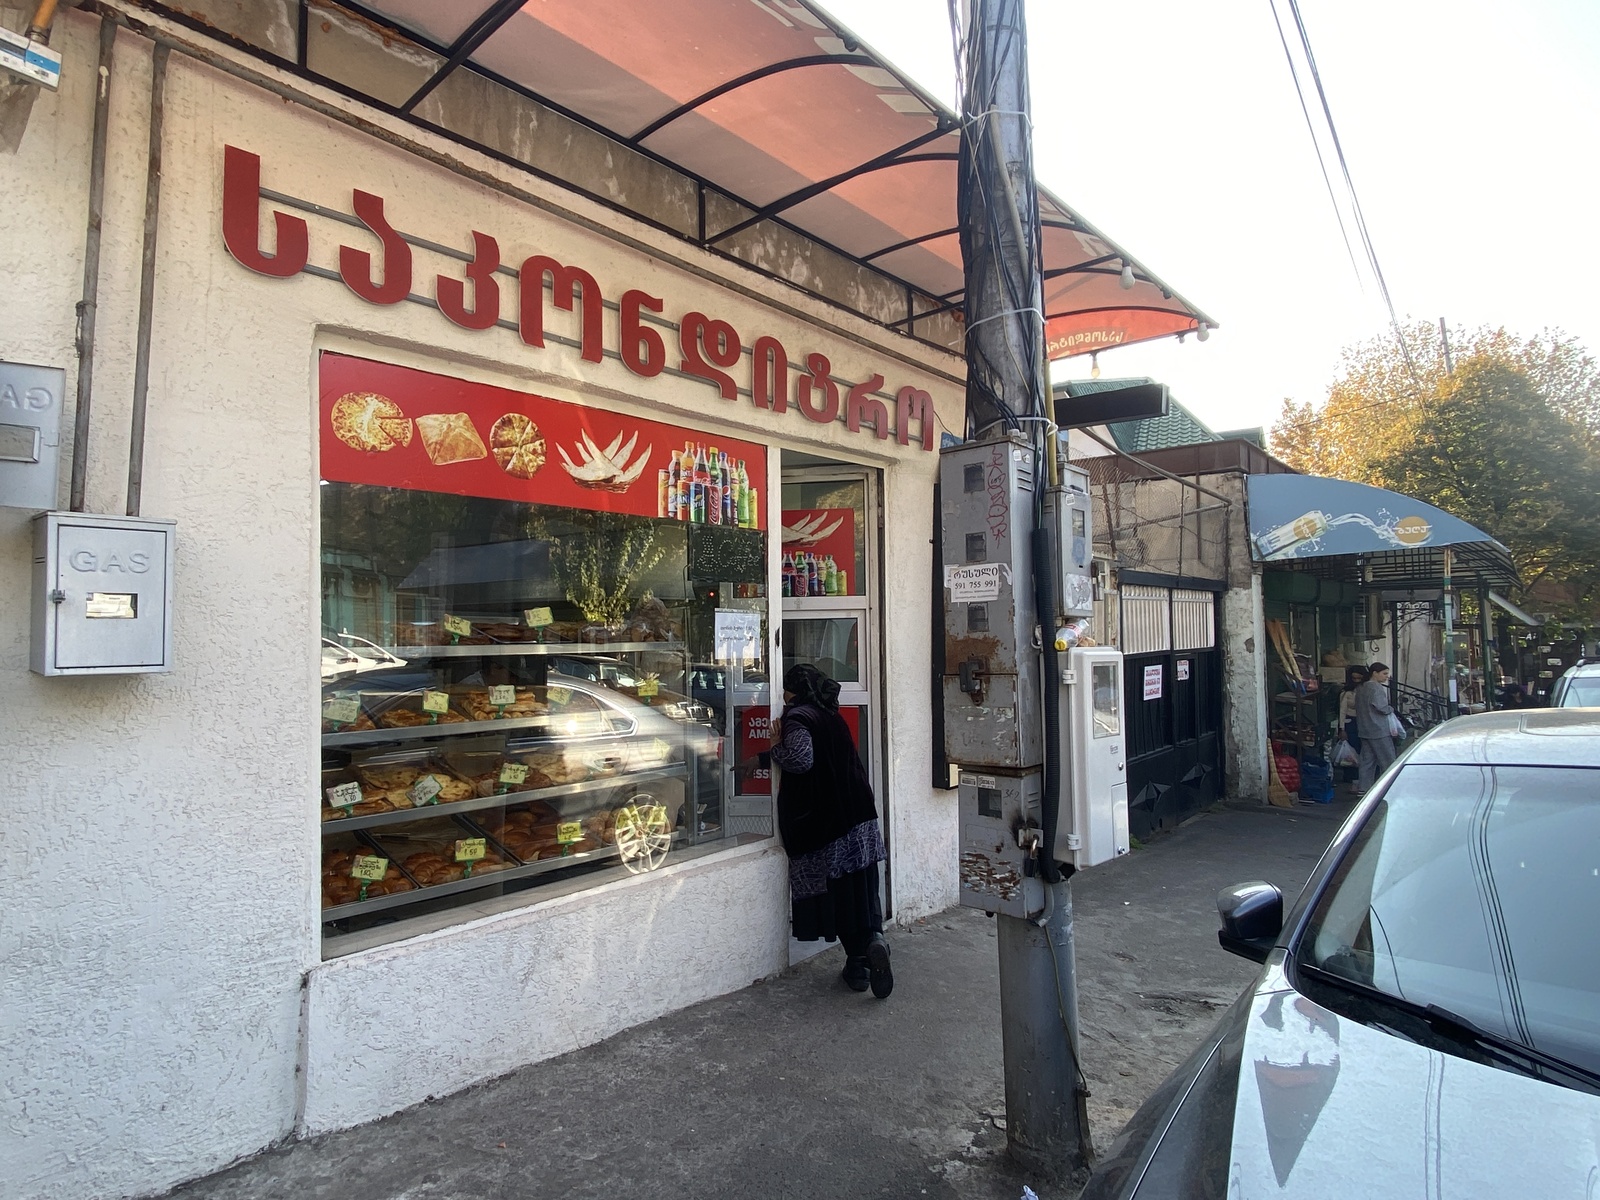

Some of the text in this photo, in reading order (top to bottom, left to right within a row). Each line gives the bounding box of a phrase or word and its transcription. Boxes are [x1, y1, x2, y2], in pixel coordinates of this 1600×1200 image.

[222, 145, 935, 452] საკონდიტრო
[69, 551, 151, 573] GAS
[954, 567, 998, 579] რუსული
